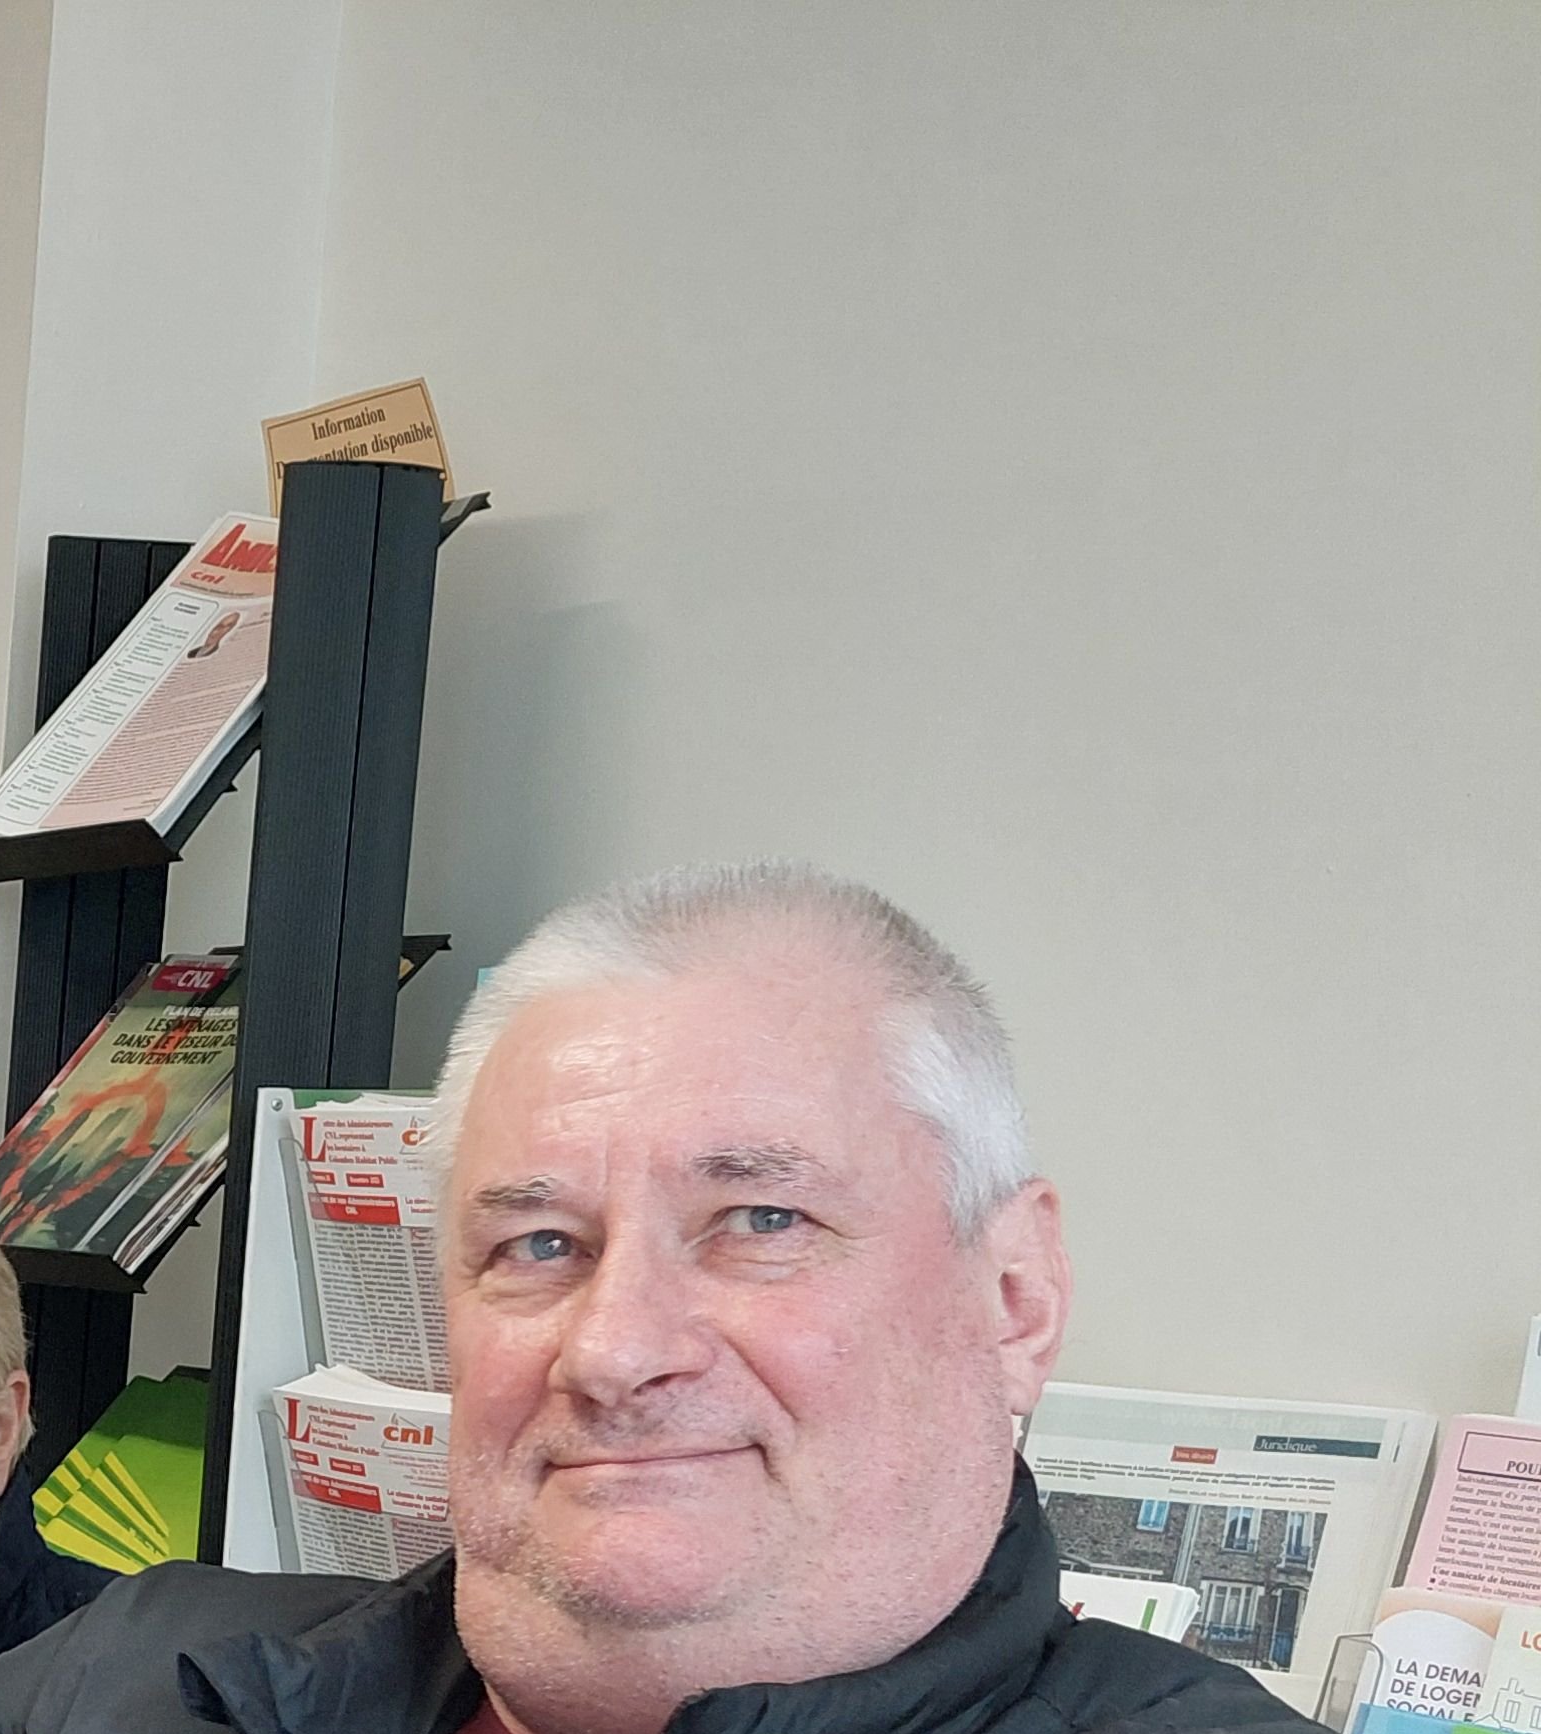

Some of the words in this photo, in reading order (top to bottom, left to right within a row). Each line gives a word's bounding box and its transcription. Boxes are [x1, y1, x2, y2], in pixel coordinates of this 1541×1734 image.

[311, 406, 386, 441] Information
[371, 420, 434, 455] disponible
[177, 969, 215, 989] CNL
[145, 1018, 172, 1032] LES
[113, 1033, 155, 1048] DANS
[153, 1034, 173, 1049] LE
[175, 1034, 221, 1049] VISEUR
[110, 1050, 221, 1065] GOUVERNEMENT
[383, 1424, 434, 1445] cnl
[1255, 1437, 1318, 1453] Juridique
[1395, 1658, 1418, 1677] LA
[1425, 1663, 1486, 1688] DEMA
[1390, 1678, 1415, 1697] DE
